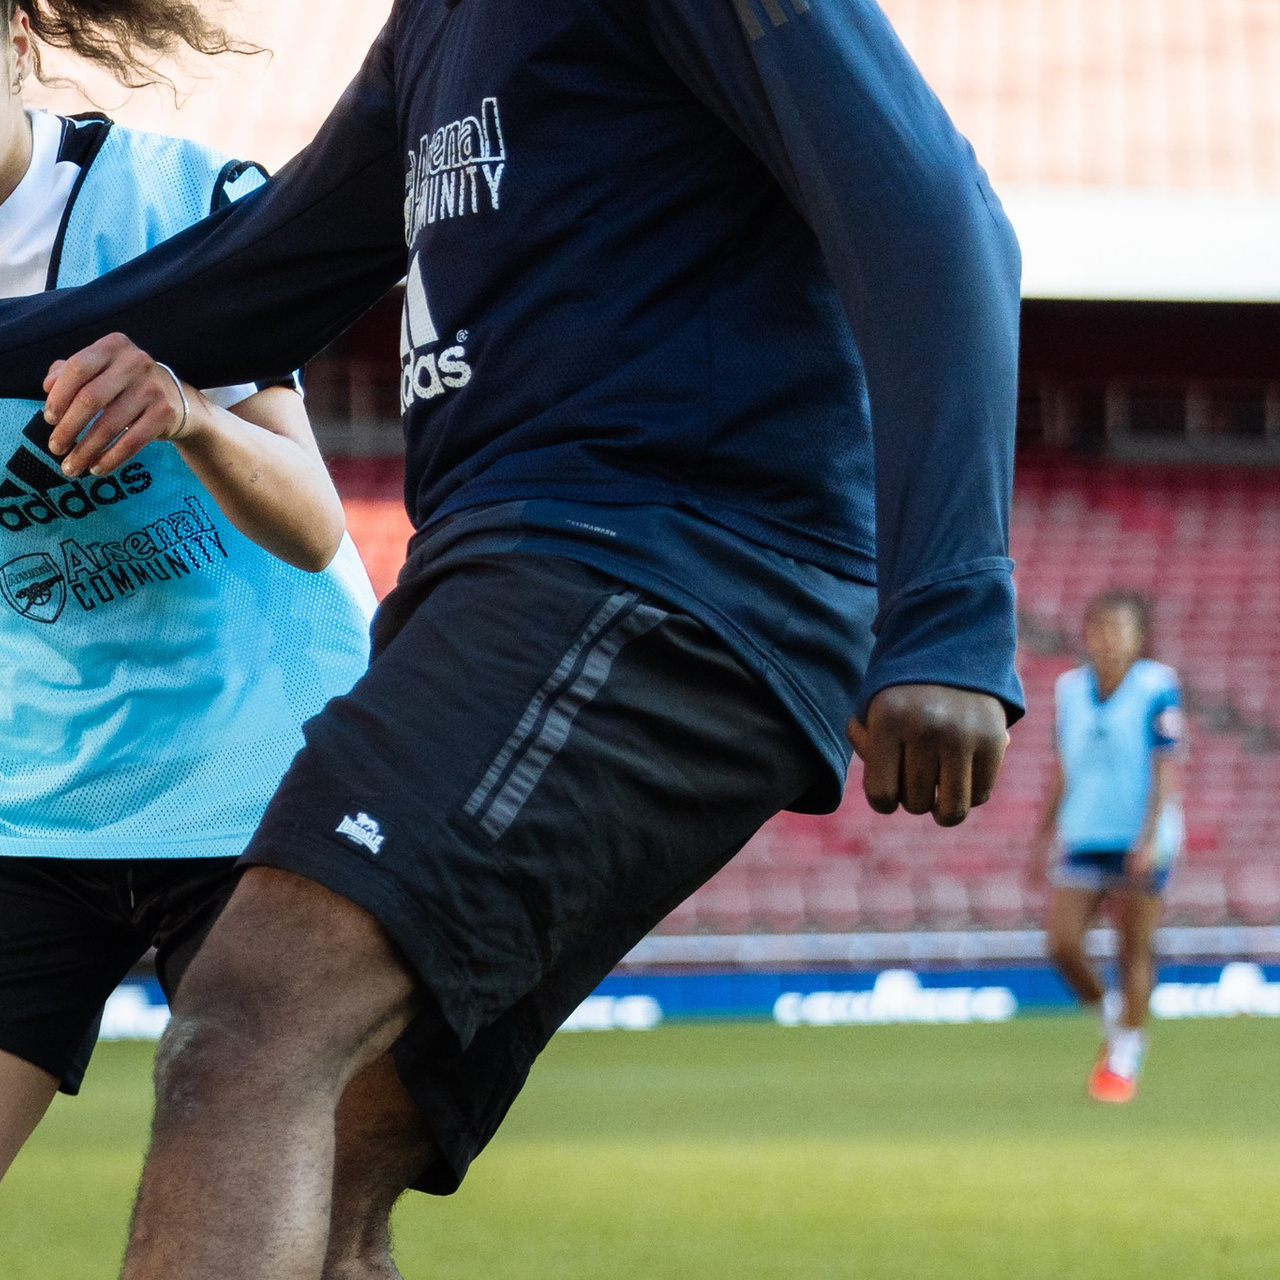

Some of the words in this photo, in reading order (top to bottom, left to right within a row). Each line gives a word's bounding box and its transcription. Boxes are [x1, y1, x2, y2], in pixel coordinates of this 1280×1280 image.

[60, 495, 216, 584] Arsenal
[71, 530, 229, 612] COMMUNITY
[335, 815, 385, 854] LONSDALE
